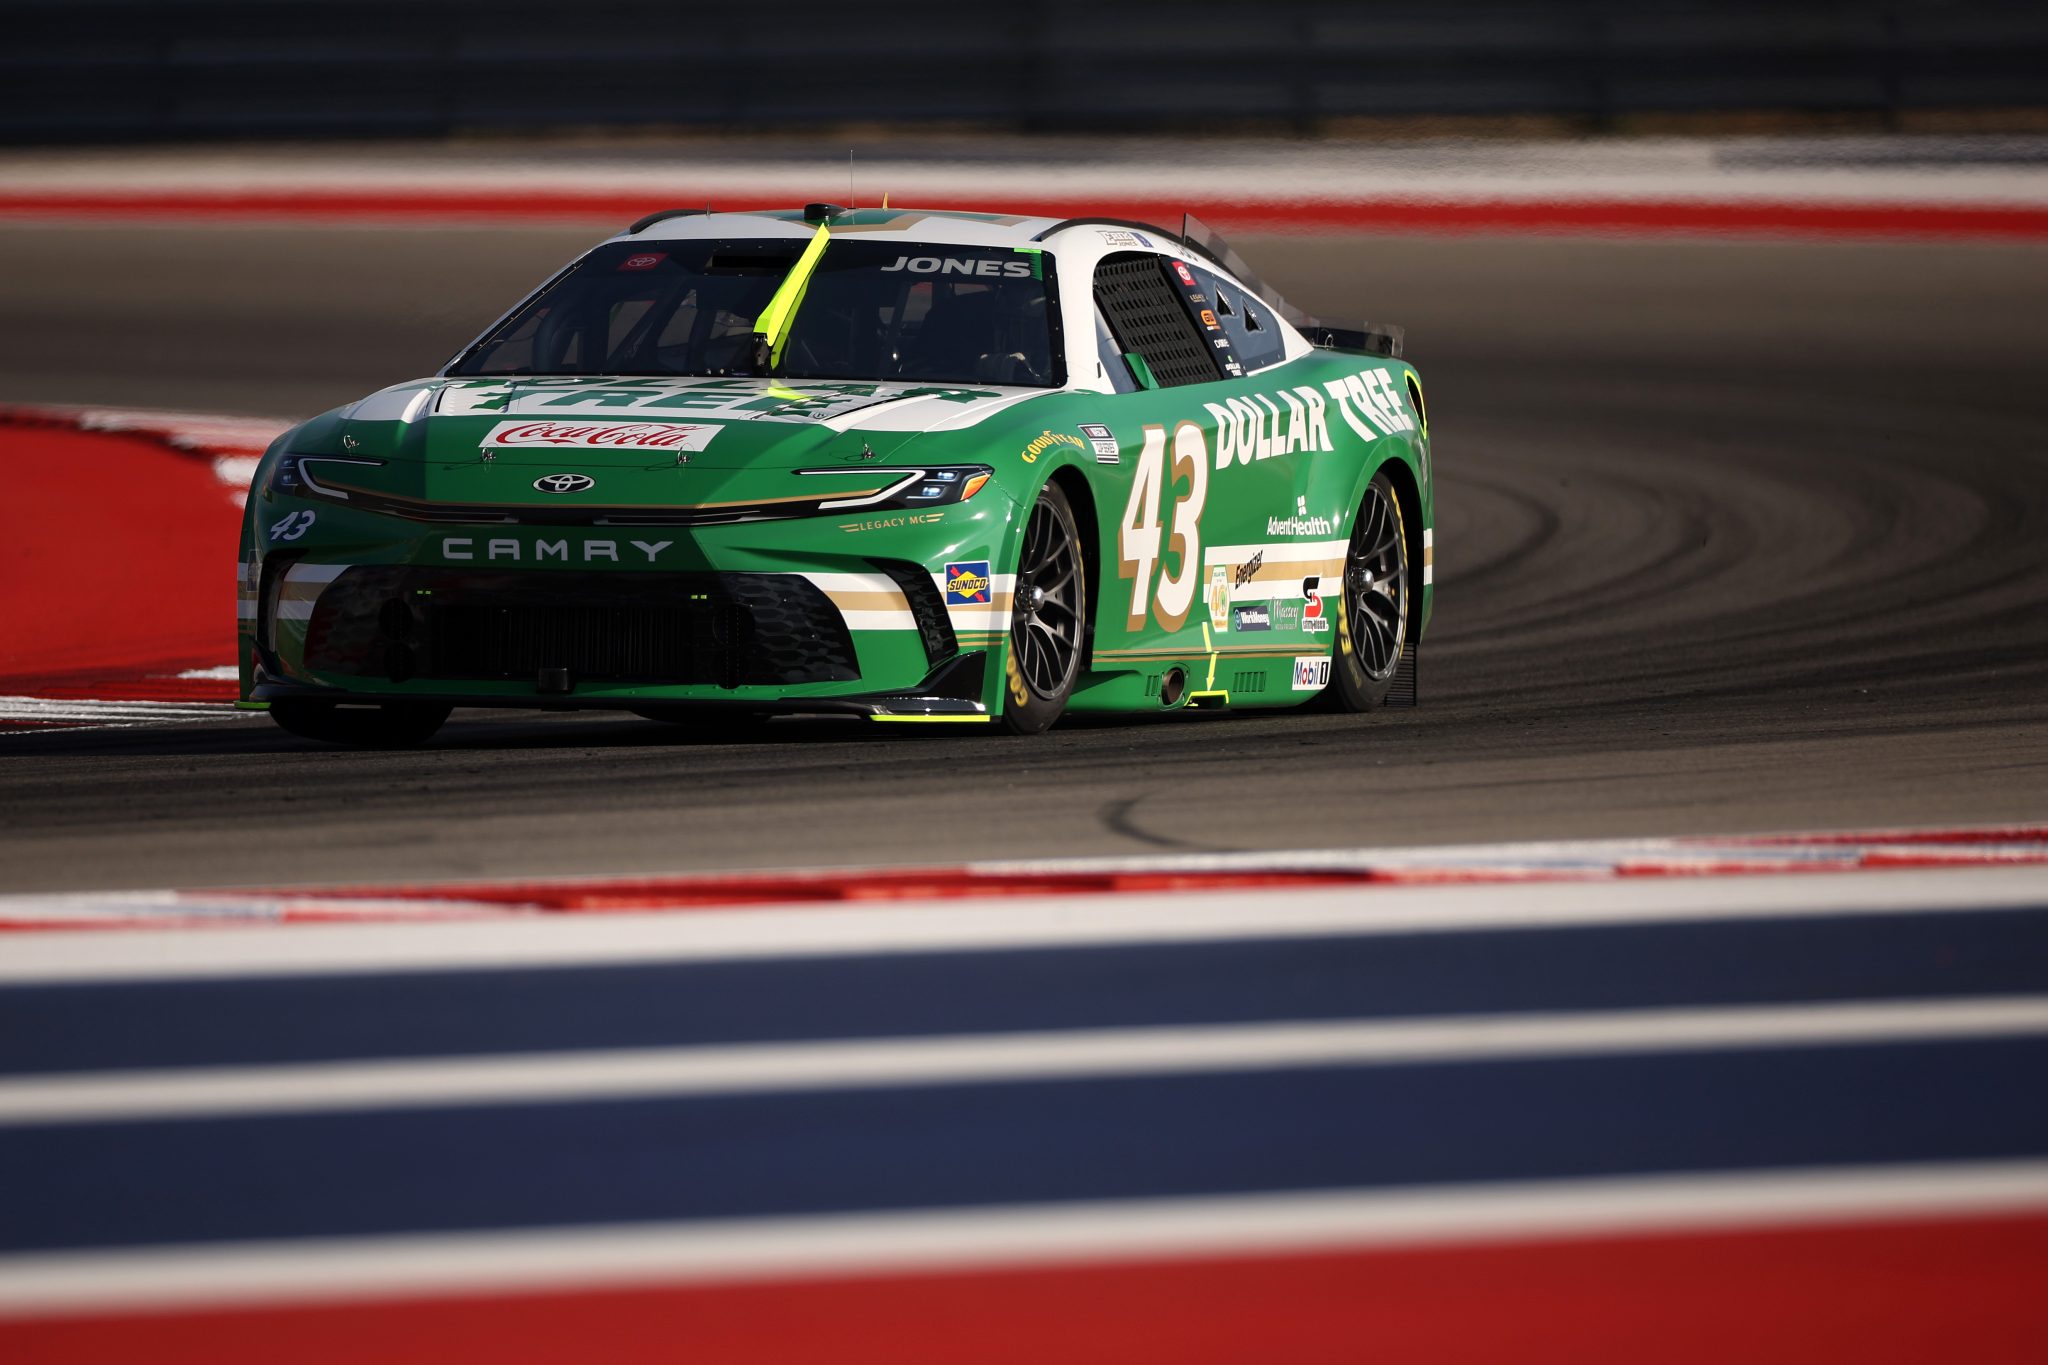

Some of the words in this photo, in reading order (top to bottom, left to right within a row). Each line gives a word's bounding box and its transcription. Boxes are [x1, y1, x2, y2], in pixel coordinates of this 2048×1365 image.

[880, 256, 1031, 278] JONES
[1203, 386, 1335, 470] DOLLAR
[1323, 367, 1415, 443] TREE
[270, 509, 317, 542] 43
[858, 517, 905, 531] LEGACY
[909, 514, 927, 525] MC
[1117, 420, 1210, 633] 43
[1266, 515, 1332, 536] AdventHealth
[442, 537, 675, 563] CAMRY
[1235, 549, 1264, 590] Energizer
[948, 577, 987, 592] SUNOCO
[1240, 610, 1270, 626] WorkMoney
[1294, 661, 1320, 685] Mobil
[1320, 661, 1330, 685] 1
